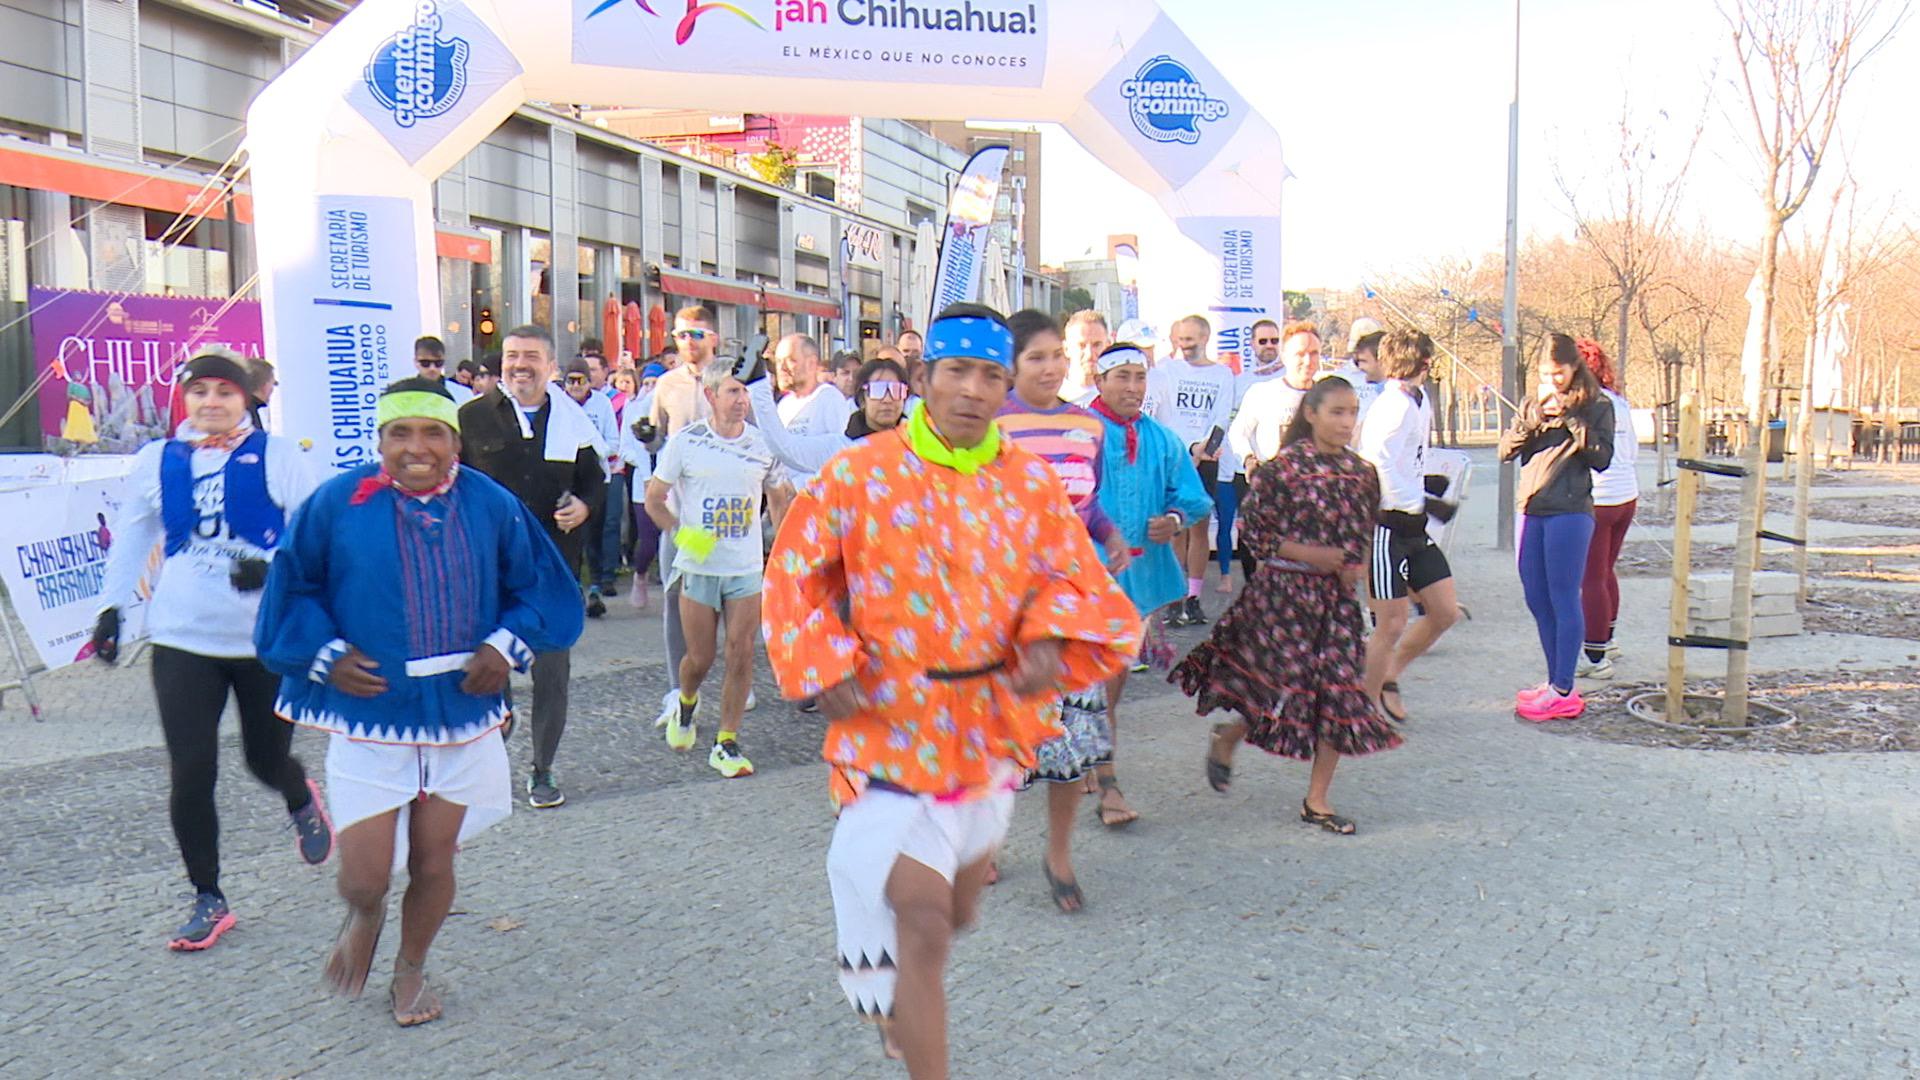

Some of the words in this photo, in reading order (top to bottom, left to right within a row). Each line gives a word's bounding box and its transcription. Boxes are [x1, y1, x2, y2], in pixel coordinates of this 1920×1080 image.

[837, 0, 1037, 34] Chihuahua!
[415, 0, 442, 111] conmigo
[783, 45, 801, 57] EL
[809, 46, 873, 61] MÉXICO
[880, 51, 913, 63] QUE
[922, 53, 943, 65] NO
[951, 55, 1028, 68] CONOCES
[392, 29, 416, 128] cuenta
[1121, 78, 1201, 99] cuenta
[1136, 97, 1229, 122] conmigo
[326, 209, 350, 290] SECRETARÍA
[349, 211, 370, 269] TURISMO
[1240, 230, 1253, 280] TURISMO
[352, 273, 371, 291] DE
[1240, 284, 1253, 299] DE
[360, 323, 376, 386] bueno
[376, 324, 390, 379] ESTADO
[326, 325, 362, 440] CHIHUAHUA
[361, 393, 377, 409] lo
[1176, 392, 1216, 411] RUN
[331, 444, 364, 470] ÁS
